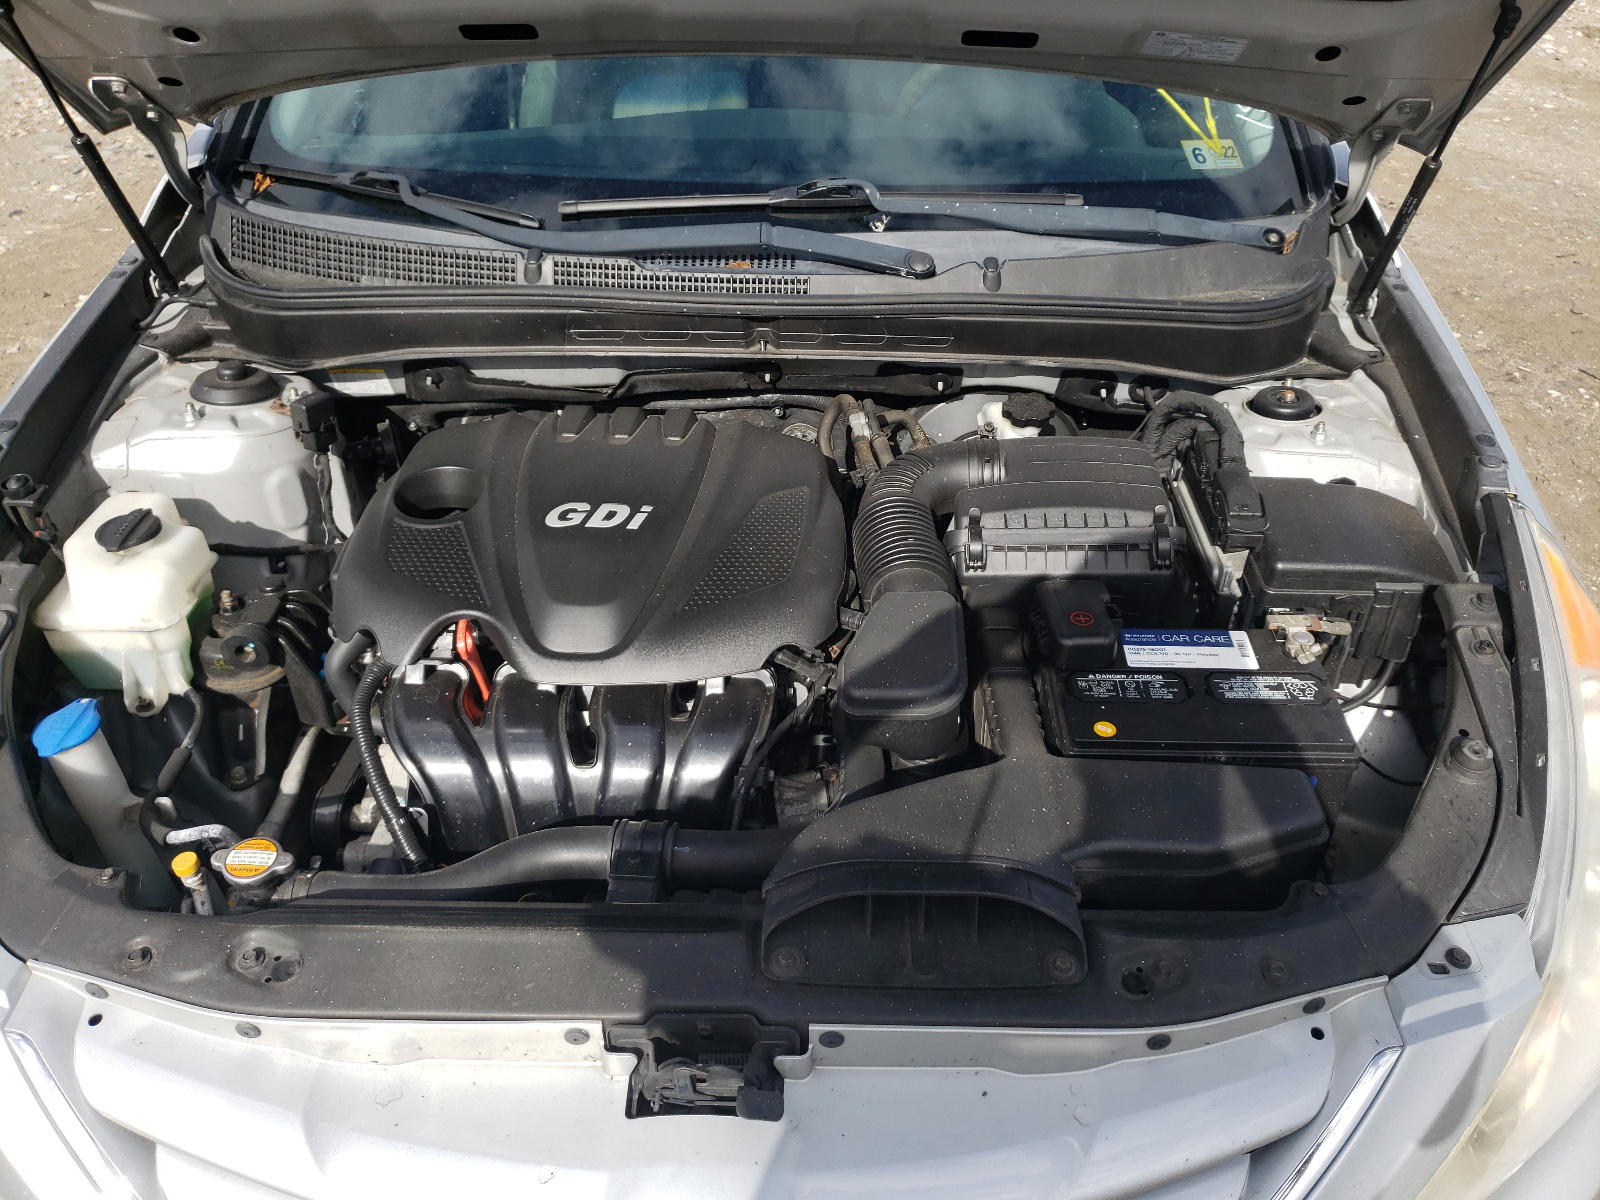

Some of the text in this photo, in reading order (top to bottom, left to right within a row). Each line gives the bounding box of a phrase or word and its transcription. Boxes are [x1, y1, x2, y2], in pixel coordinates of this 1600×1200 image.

[1192, 147, 1207, 164] 6
[1221, 145, 1238, 159] 22
[544, 502, 654, 530] GDi
[1161, 634, 1231, 644] CAR CARE
